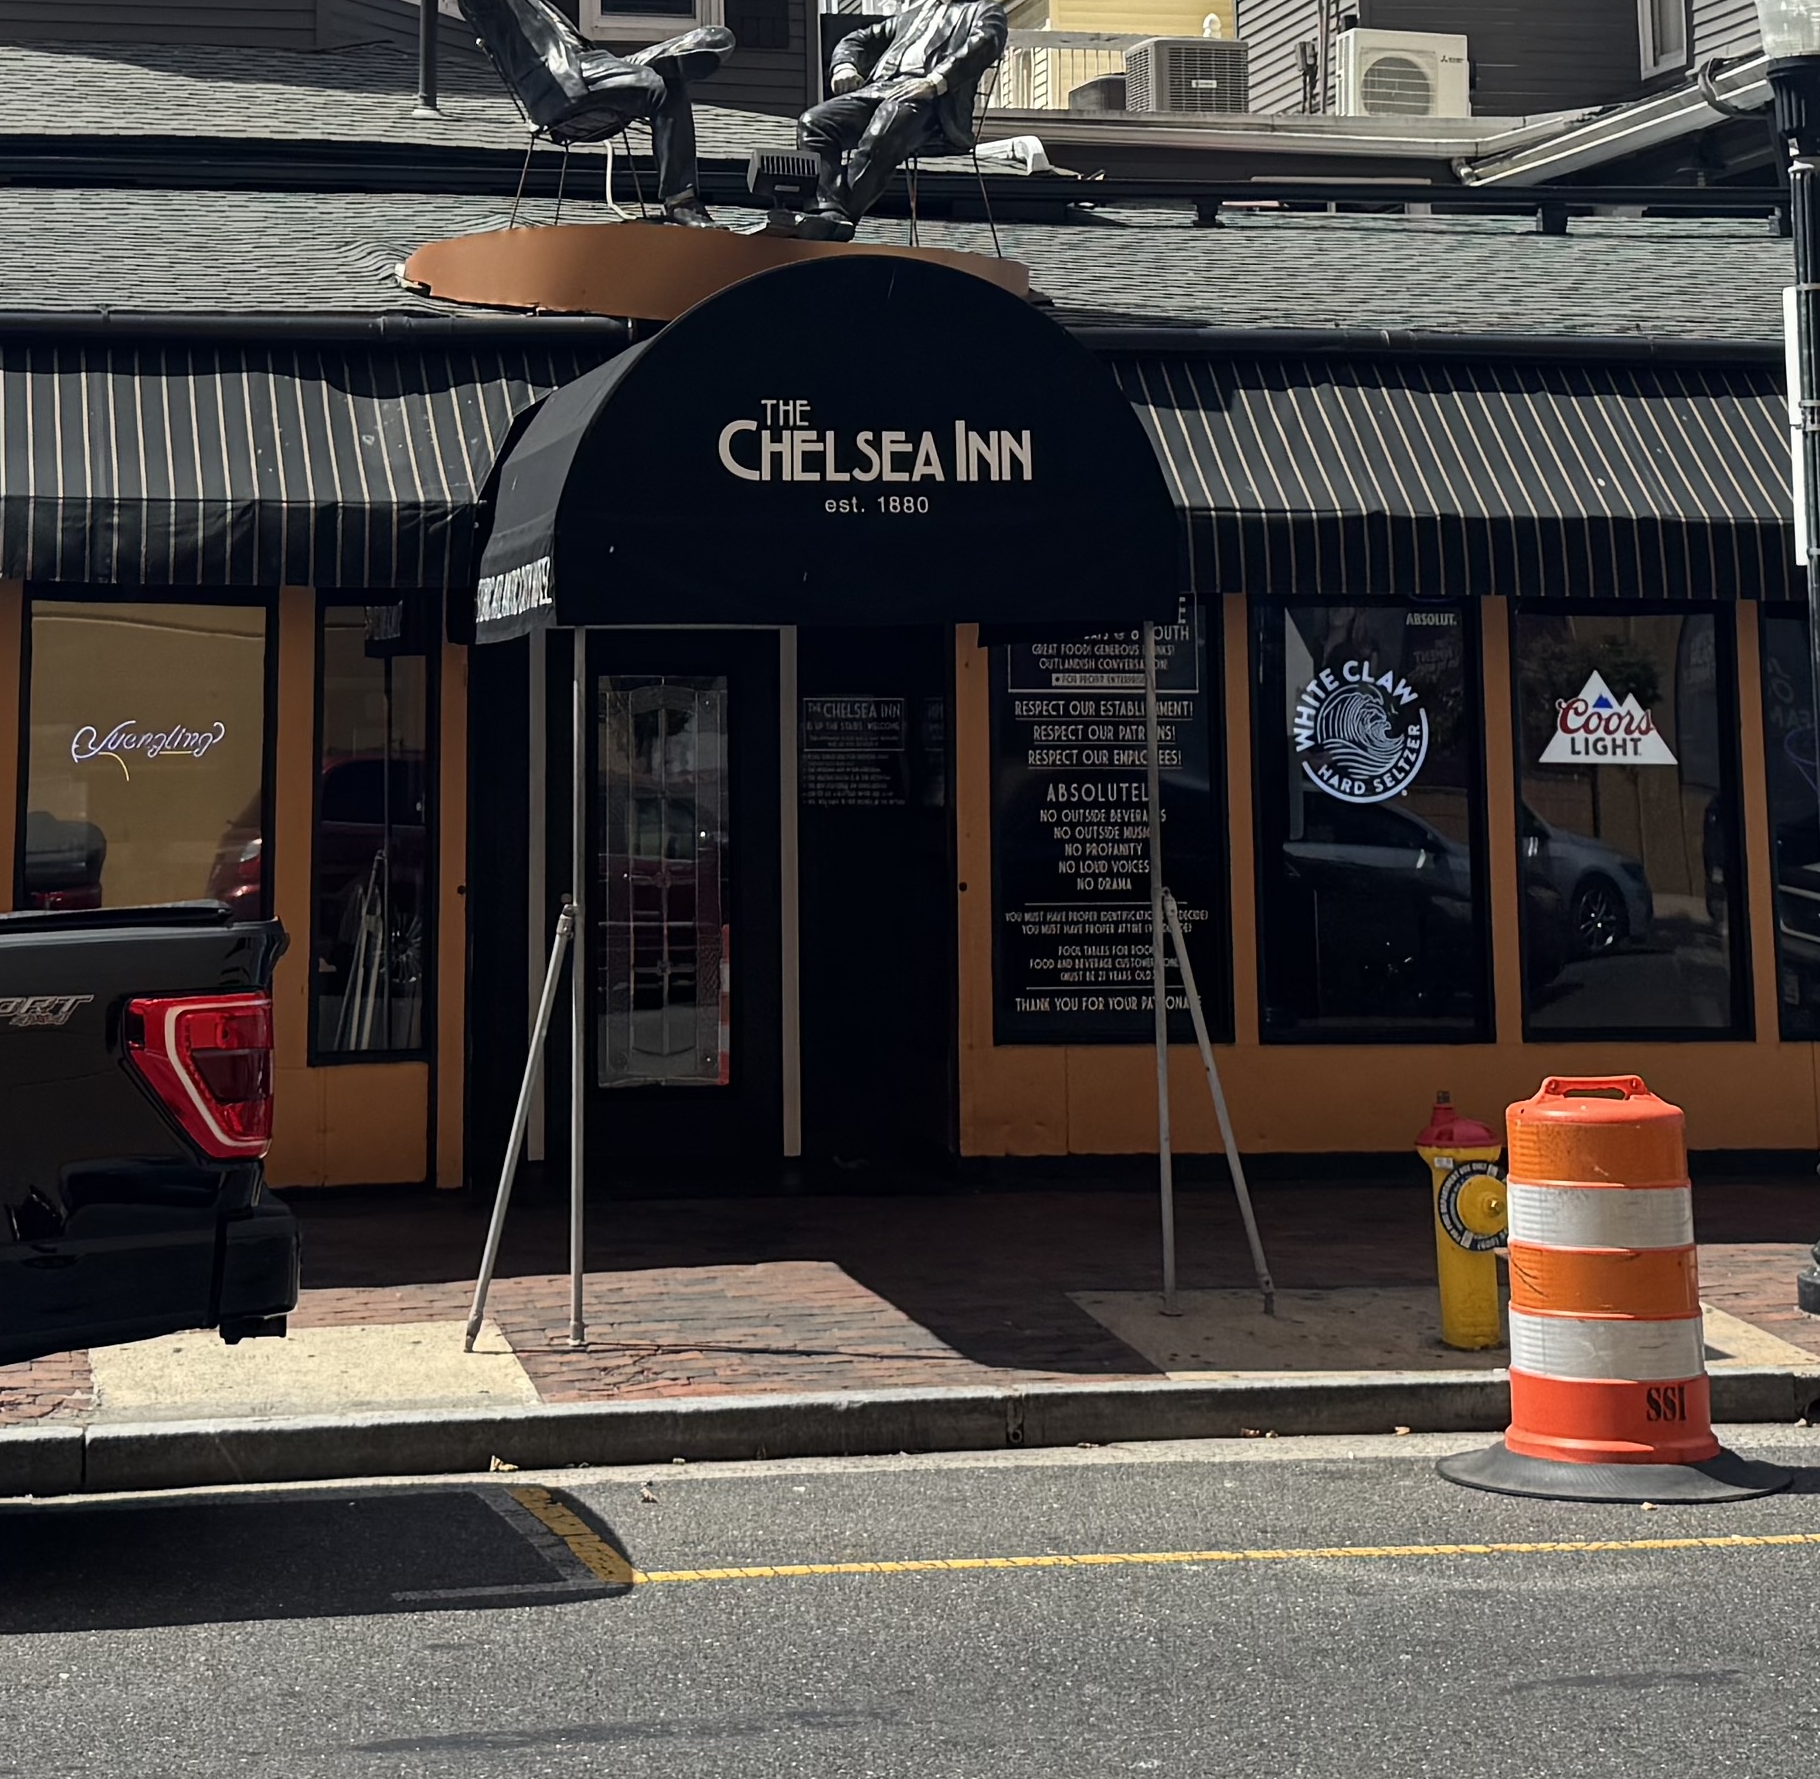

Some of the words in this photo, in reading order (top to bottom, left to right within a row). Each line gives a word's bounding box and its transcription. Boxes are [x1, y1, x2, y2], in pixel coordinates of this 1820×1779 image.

[761, 400, 811, 426] THE
[719, 420, 945, 482] CHELSEA
[954, 420, 1032, 482] INN
[825, 496, 865, 513] est.
[877, 496, 929, 513] 1880
[1039, 657, 1095, 670] OUTLANDISH
[823, 703, 877, 718] CHELSEA
[880, 703, 900, 718] INN
[1015, 700, 1065, 716] RESPECT
[1069, 700, 1096, 716] OUR
[1293, 668, 1340, 753] WHITE
[1342, 660, 1419, 706] CLAW
[1556, 698, 1656, 736] Coors
[1033, 725, 1083, 741] RESPECT
[1088, 725, 1114, 741] OUR
[1118, 725, 1176, 741] PATRNS!
[71, 720, 226, 776] Yuengling
[1571, 737, 1641, 756] LIGHT
[1028, 749, 1078, 765] RESPECT
[1082, 749, 1109, 765] OUR
[1318, 763, 1366, 795] HARD
[1373, 724, 1421, 792] SELTZER
[1040, 809, 1056, 822] NO
[1061, 809, 1106, 822] OUTSIDE
[1054, 826, 1071, 839] NO
[1075, 826, 1120, 839] OUTSIDE
[1065, 843, 1082, 856] NO
[1085, 843, 1142, 856] PROFANITY
[1059, 860, 1075, 874] NO
[1079, 860, 1108, 874] LOUD
[1112, 860, 1150, 873] VOICES
[1077, 877, 1093, 890] NO
[1098, 877, 1132, 890] DRAMA
[1005, 911, 1022, 922] YOU
[1022, 924, 1039, 934] YOU
[1029, 959, 1055, 969] FOOD
[1015, 997, 1050, 1012] THANK
[1054, 997, 1079, 1012] YOU
[1082, 997, 1104, 1011] FOR
[1109, 996, 1137, 1011] YOUR
[1647, 1386, 1686, 1422] SSI
